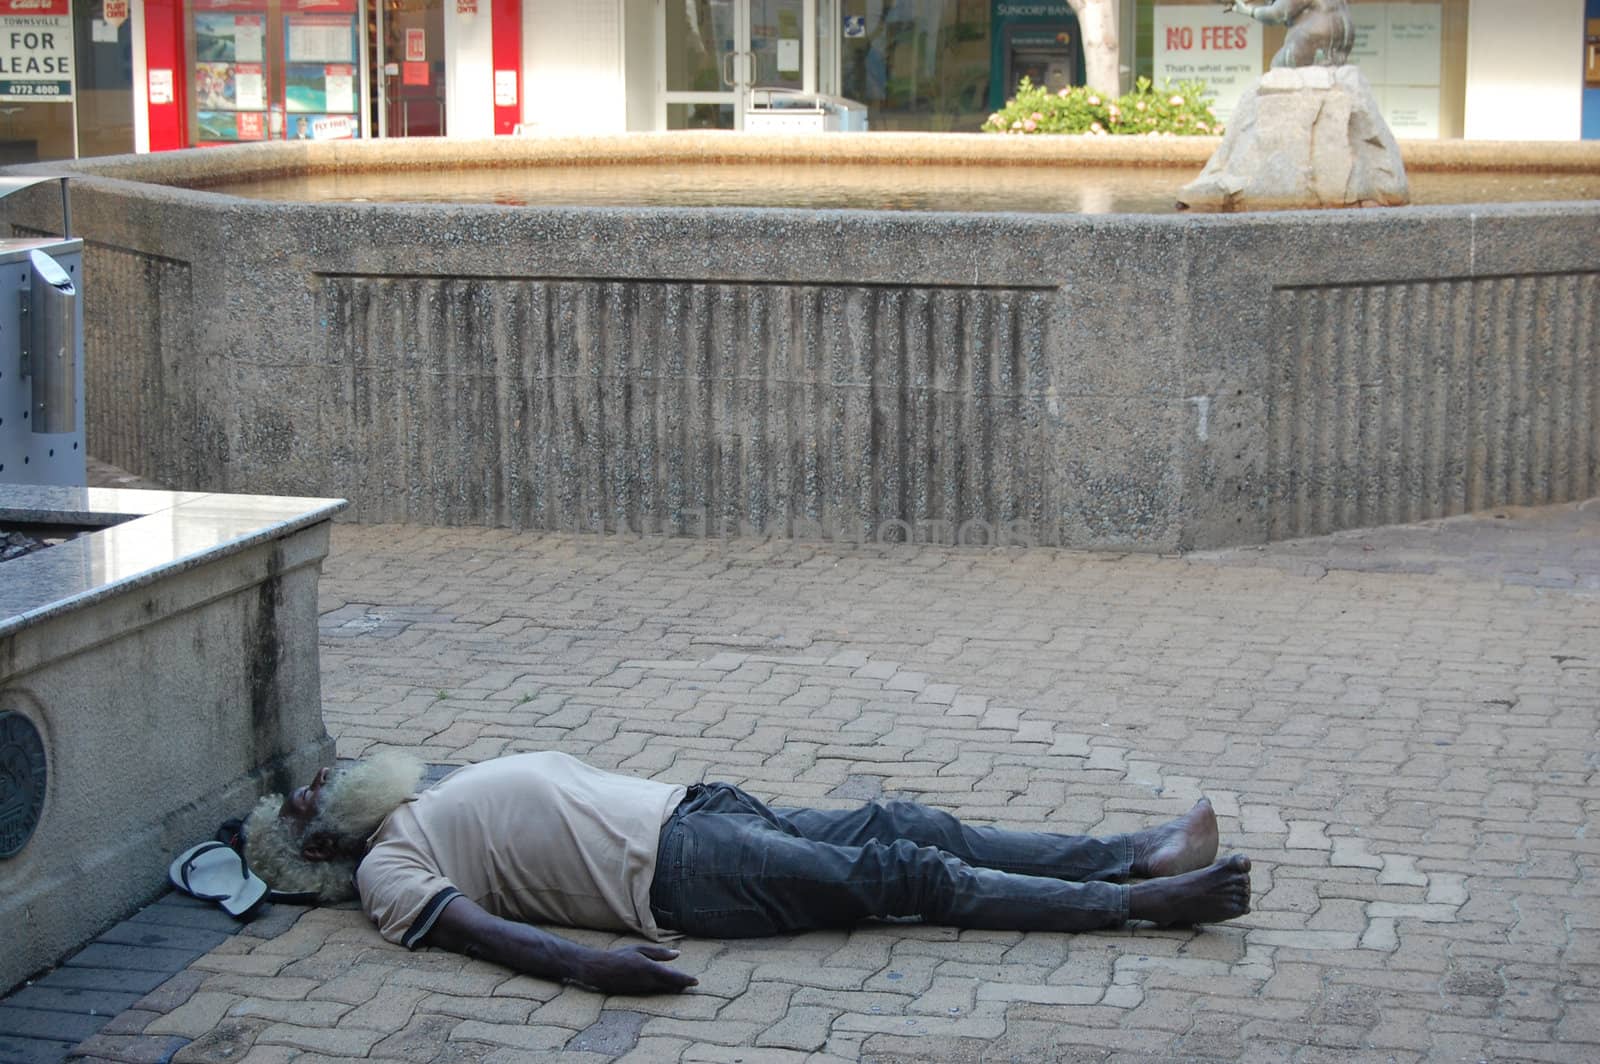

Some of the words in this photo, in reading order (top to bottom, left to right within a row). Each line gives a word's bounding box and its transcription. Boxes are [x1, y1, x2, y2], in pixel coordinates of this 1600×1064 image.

[997, 4, 1046, 16] SUNCORP
[4, 17, 59, 26] TOWNSVILLE
[10, 33, 54, 49] FOR
[1166, 26, 1193, 51] NO
[1201, 26, 1248, 51] FEES
[0, 57, 69, 73] LEASE
[1165, 64, 1194, 72] That's
[1198, 64, 1221, 72] what
[1225, 64, 1251, 72] we're
[1211, 75, 1234, 83] local
[10, 85, 32, 94] 4772
[35, 85, 59, 94] 4000
